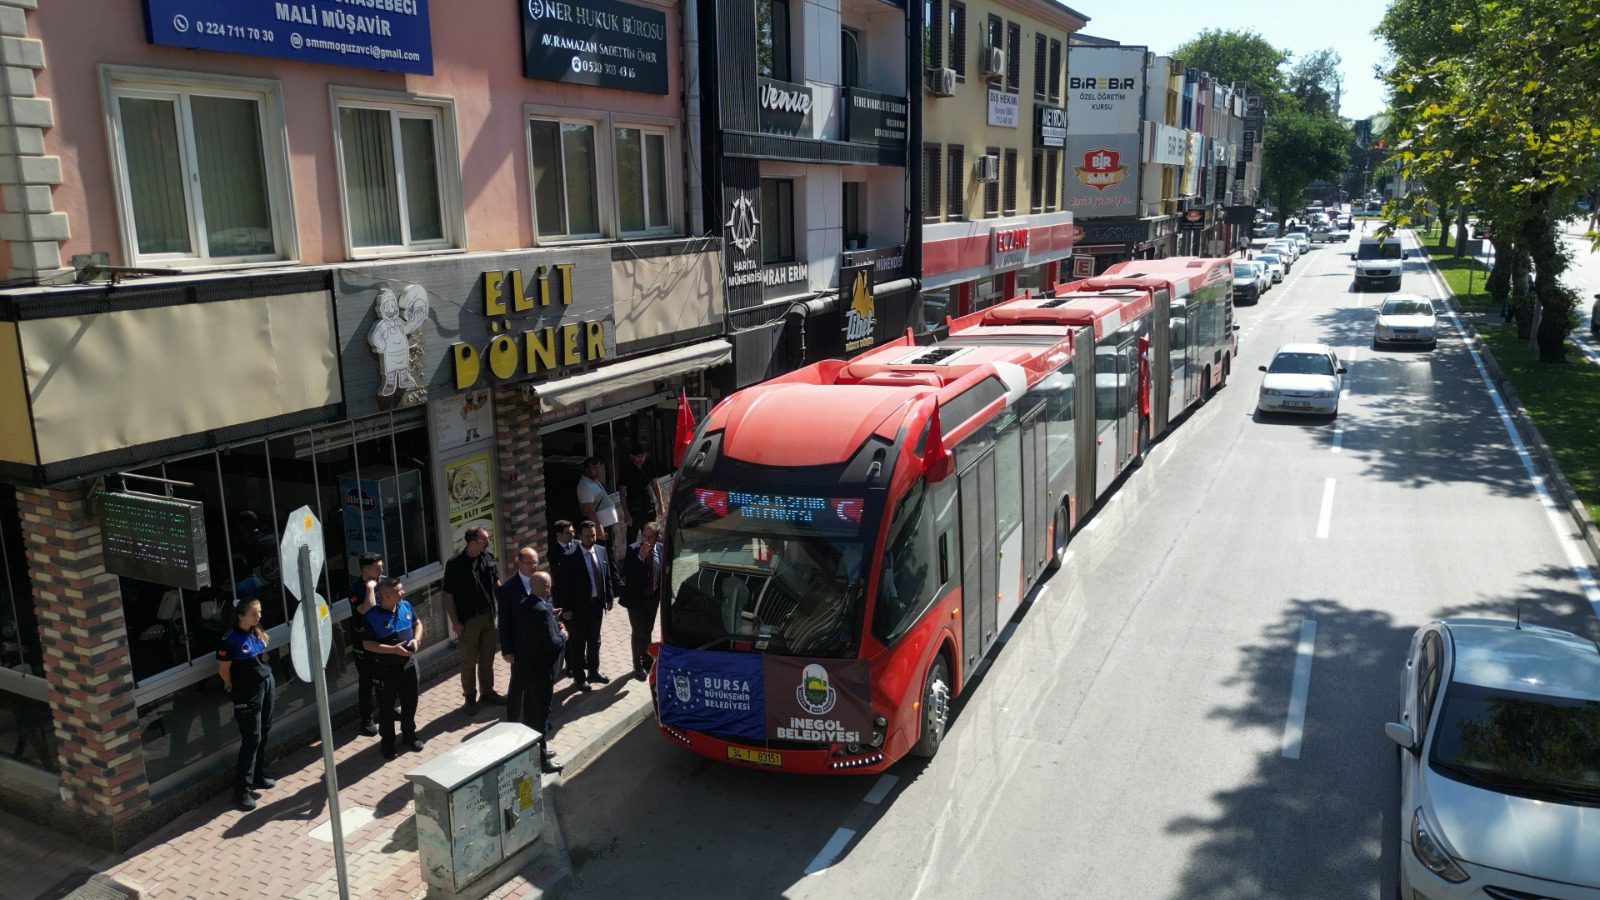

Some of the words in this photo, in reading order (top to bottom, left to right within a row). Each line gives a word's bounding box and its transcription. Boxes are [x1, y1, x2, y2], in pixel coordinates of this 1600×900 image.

[275, 2, 318, 26] MALİ
[322, 10, 392, 37] MÜŞAVİR
[576, 6, 619, 31] HUKUK
[622, 16, 664, 40] BÜROSU
[197, 21, 204, 32] 0
[206, 22, 225, 36] 224
[227, 25, 245, 39] 711
[247, 27, 260, 40] 70
[262, 30, 274, 42] 30
[1080, 92, 1096, 101] ÖZEL
[1097, 92, 1126, 101] ÖĞRETİM
[1091, 103, 1113, 111] KURSU
[1042, 107, 1067, 128] METRON
[733, 259, 757, 272] HARİTA
[1079, 261, 1091, 273] E
[762, 266, 786, 286] MRAH
[788, 262, 808, 282] ERİM
[451, 319, 607, 389] DÖNER
[704, 677, 750, 692] BURSA
[704, 689, 750, 701] BÜYÜKŞEHİR
[704, 699, 750, 711] BELEDİYESİ
[732, 748, 742, 758] 34
[747, 750, 752, 759] T
[758, 752, 779, 764] 83151
